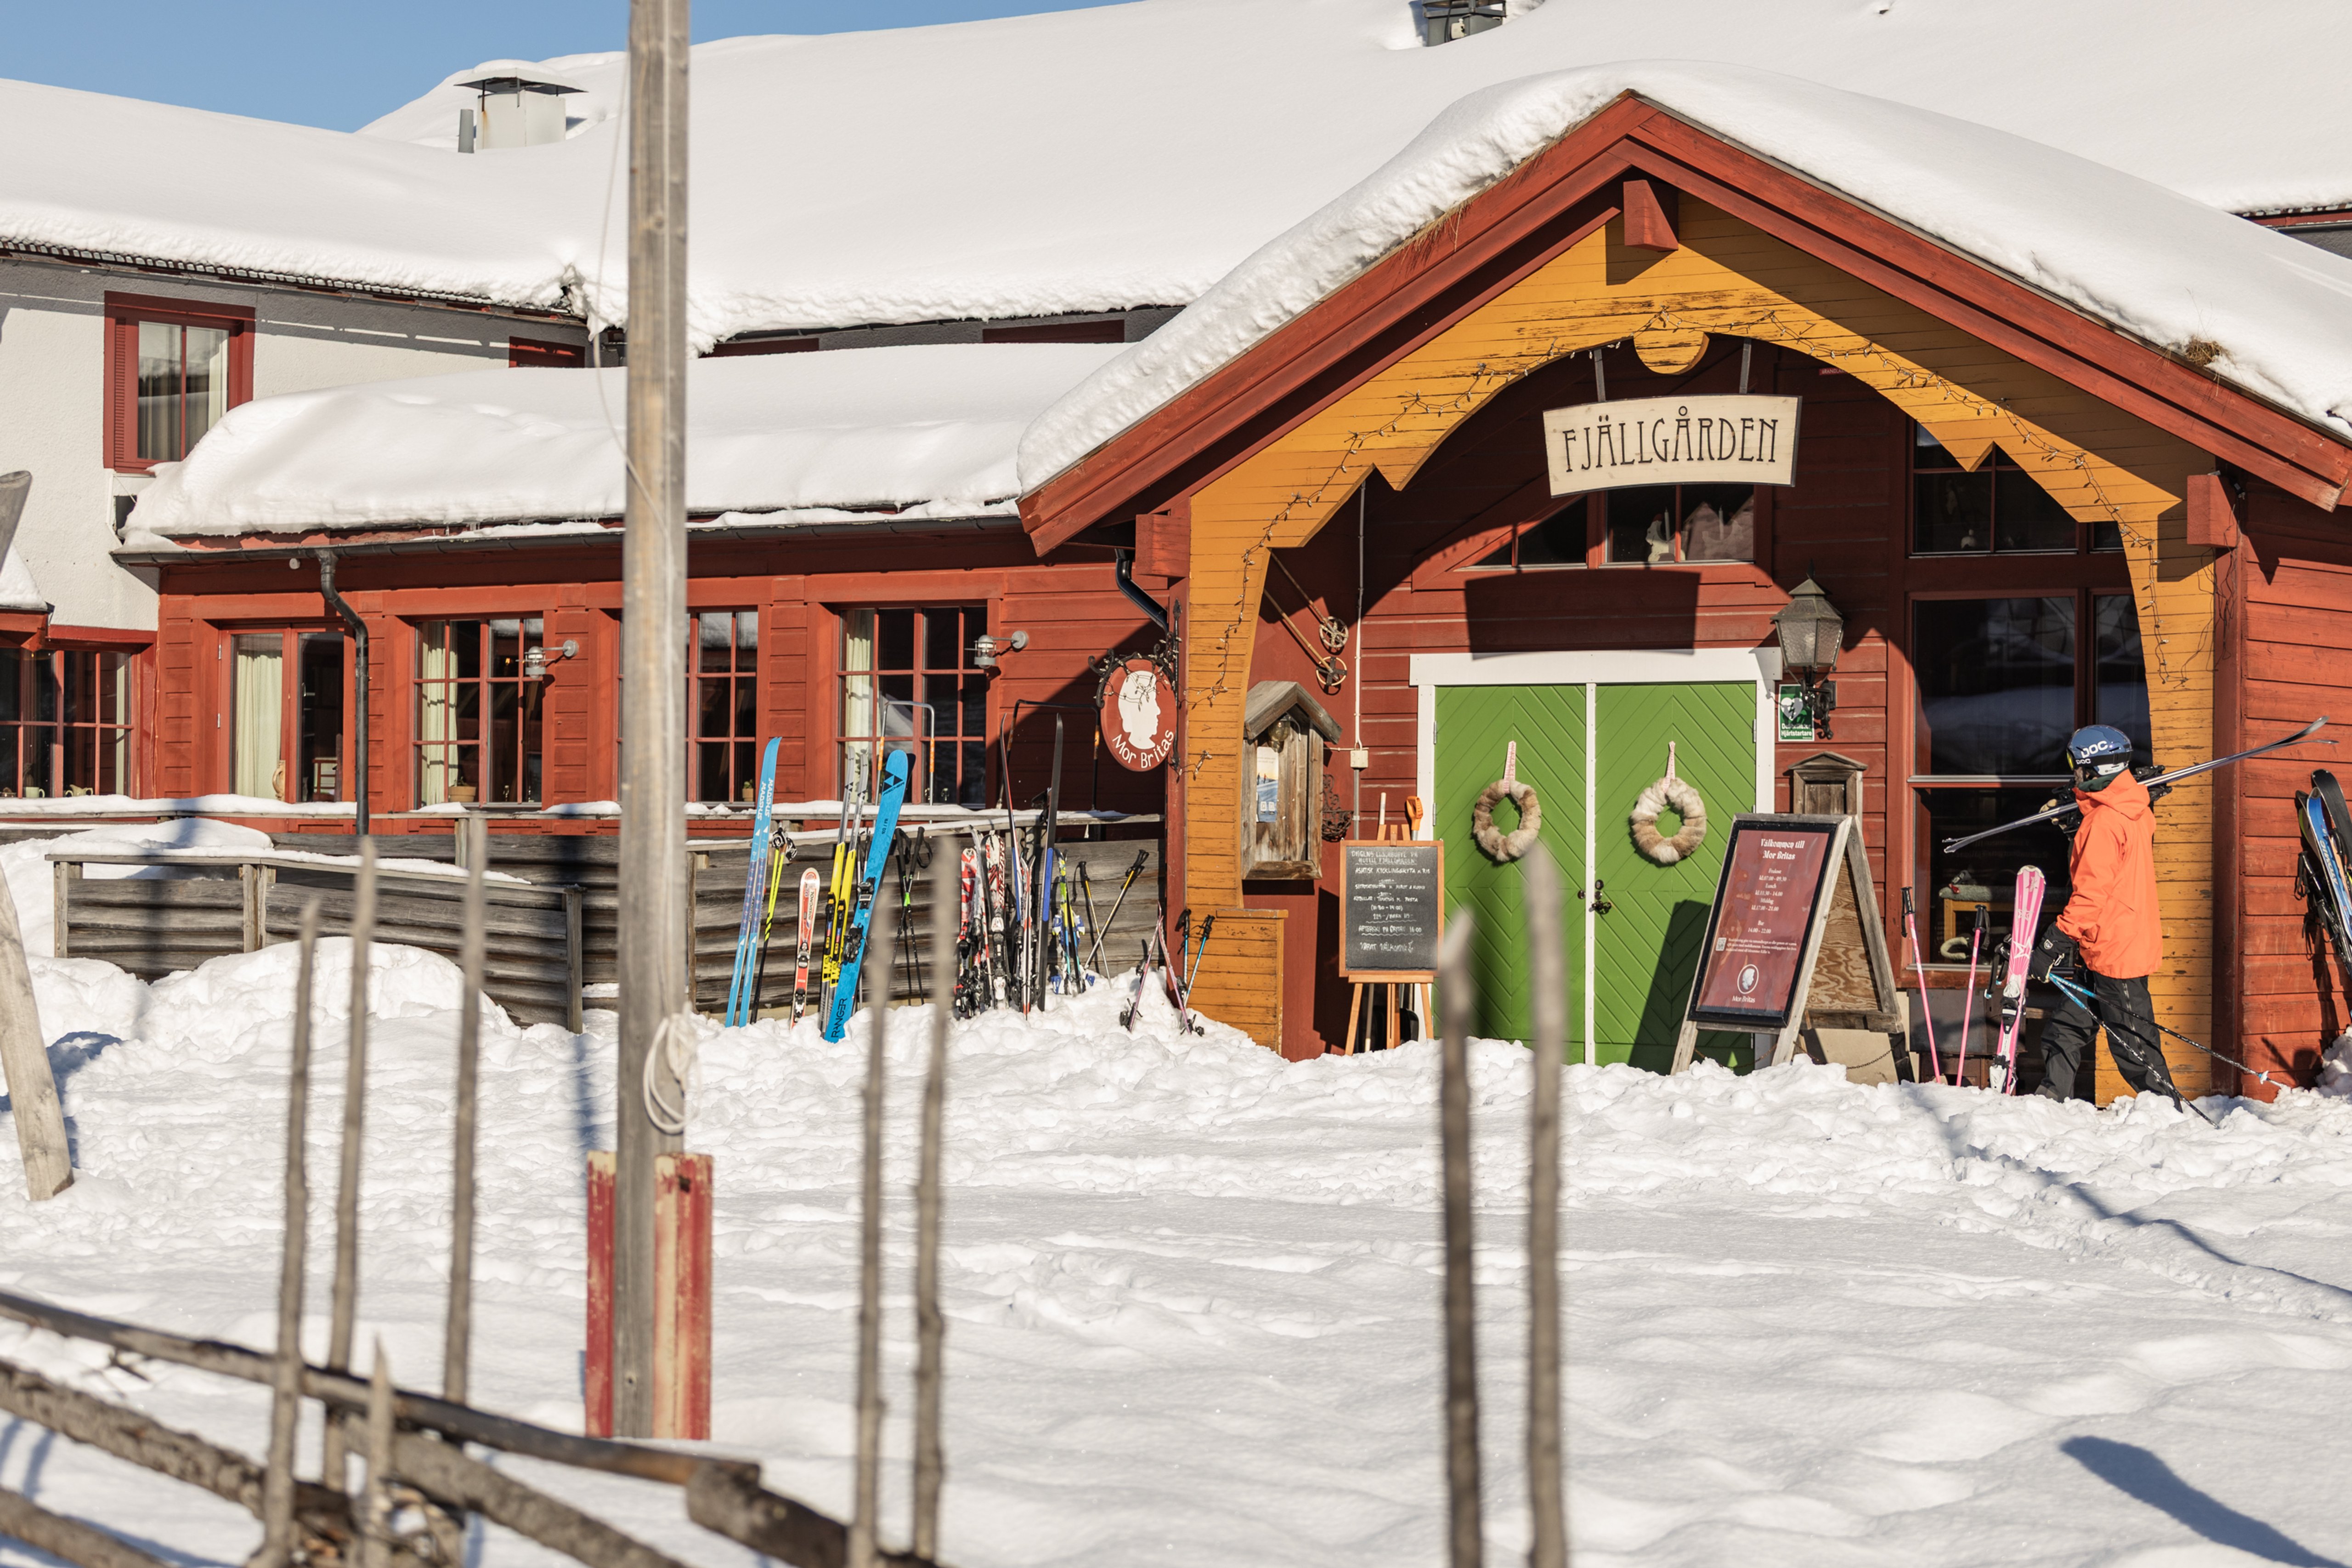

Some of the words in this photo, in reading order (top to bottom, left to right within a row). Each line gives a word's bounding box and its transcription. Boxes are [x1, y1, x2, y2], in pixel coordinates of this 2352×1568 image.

[1562, 405, 1779, 472] FJÄLLGÅRDEN
[1112, 733, 1136, 764] Mor
[1140, 730, 1174, 769] Britas
[757, 781, 767, 821] MADSHUS
[764, 777, 774, 817] MADSHUS
[1761, 838, 1794, 849] Välkommen
[1795, 840, 1805, 849] till
[1763, 850, 1776, 859] Mor
[1776, 851, 1796, 860] Britas
[831, 998, 848, 1038] RANGER
